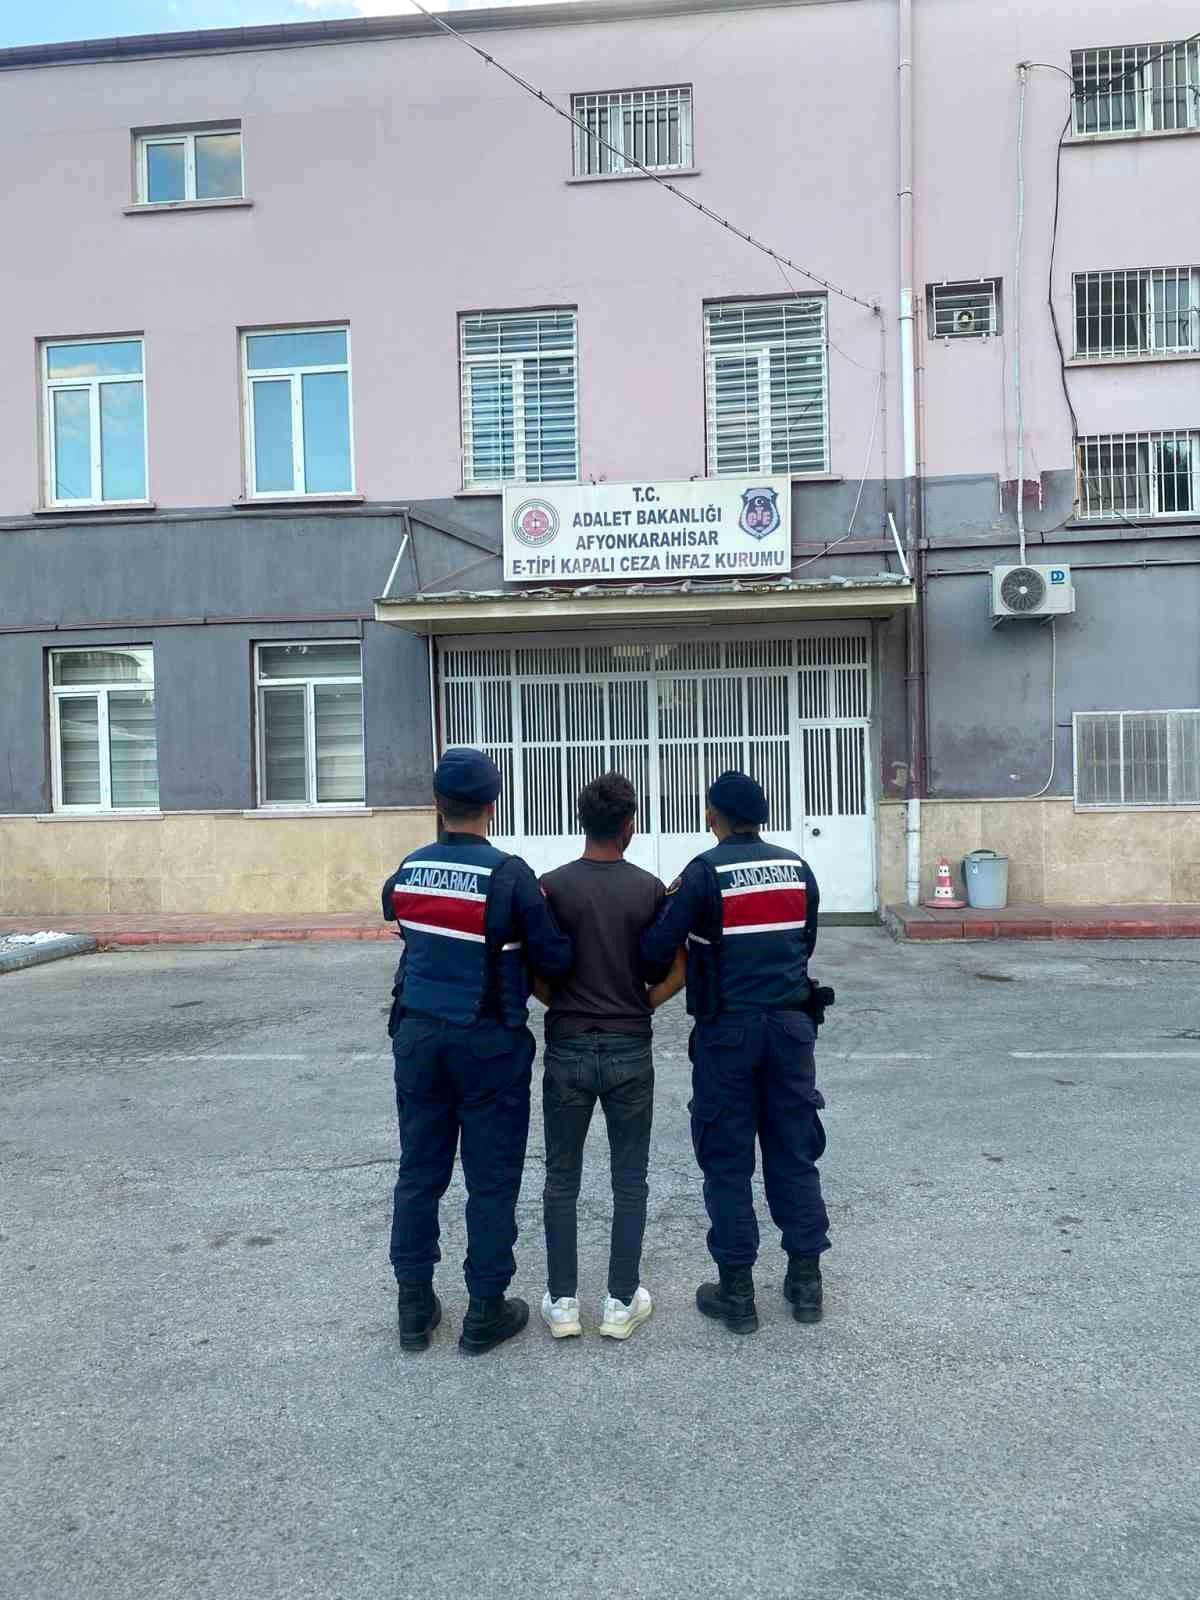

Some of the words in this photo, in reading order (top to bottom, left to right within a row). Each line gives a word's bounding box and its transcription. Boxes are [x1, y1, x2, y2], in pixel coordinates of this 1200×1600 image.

[632, 487, 660, 502] T.C.
[572, 510, 632, 528] ADALET
[637, 504, 722, 525] BAKANLIĞI
[575, 528, 719, 550] AFYONKARAHİSAR
[512, 555, 555, 575] E-TİPİ
[560, 557, 615, 574] KAPALI
[620, 555, 661, 572] CEZA
[665, 551, 710, 570] İNFAZ
[715, 551, 785, 569] KURUMU
[405, 868, 478, 894] JANDARMA
[729, 865, 799, 888] JANDARMA
